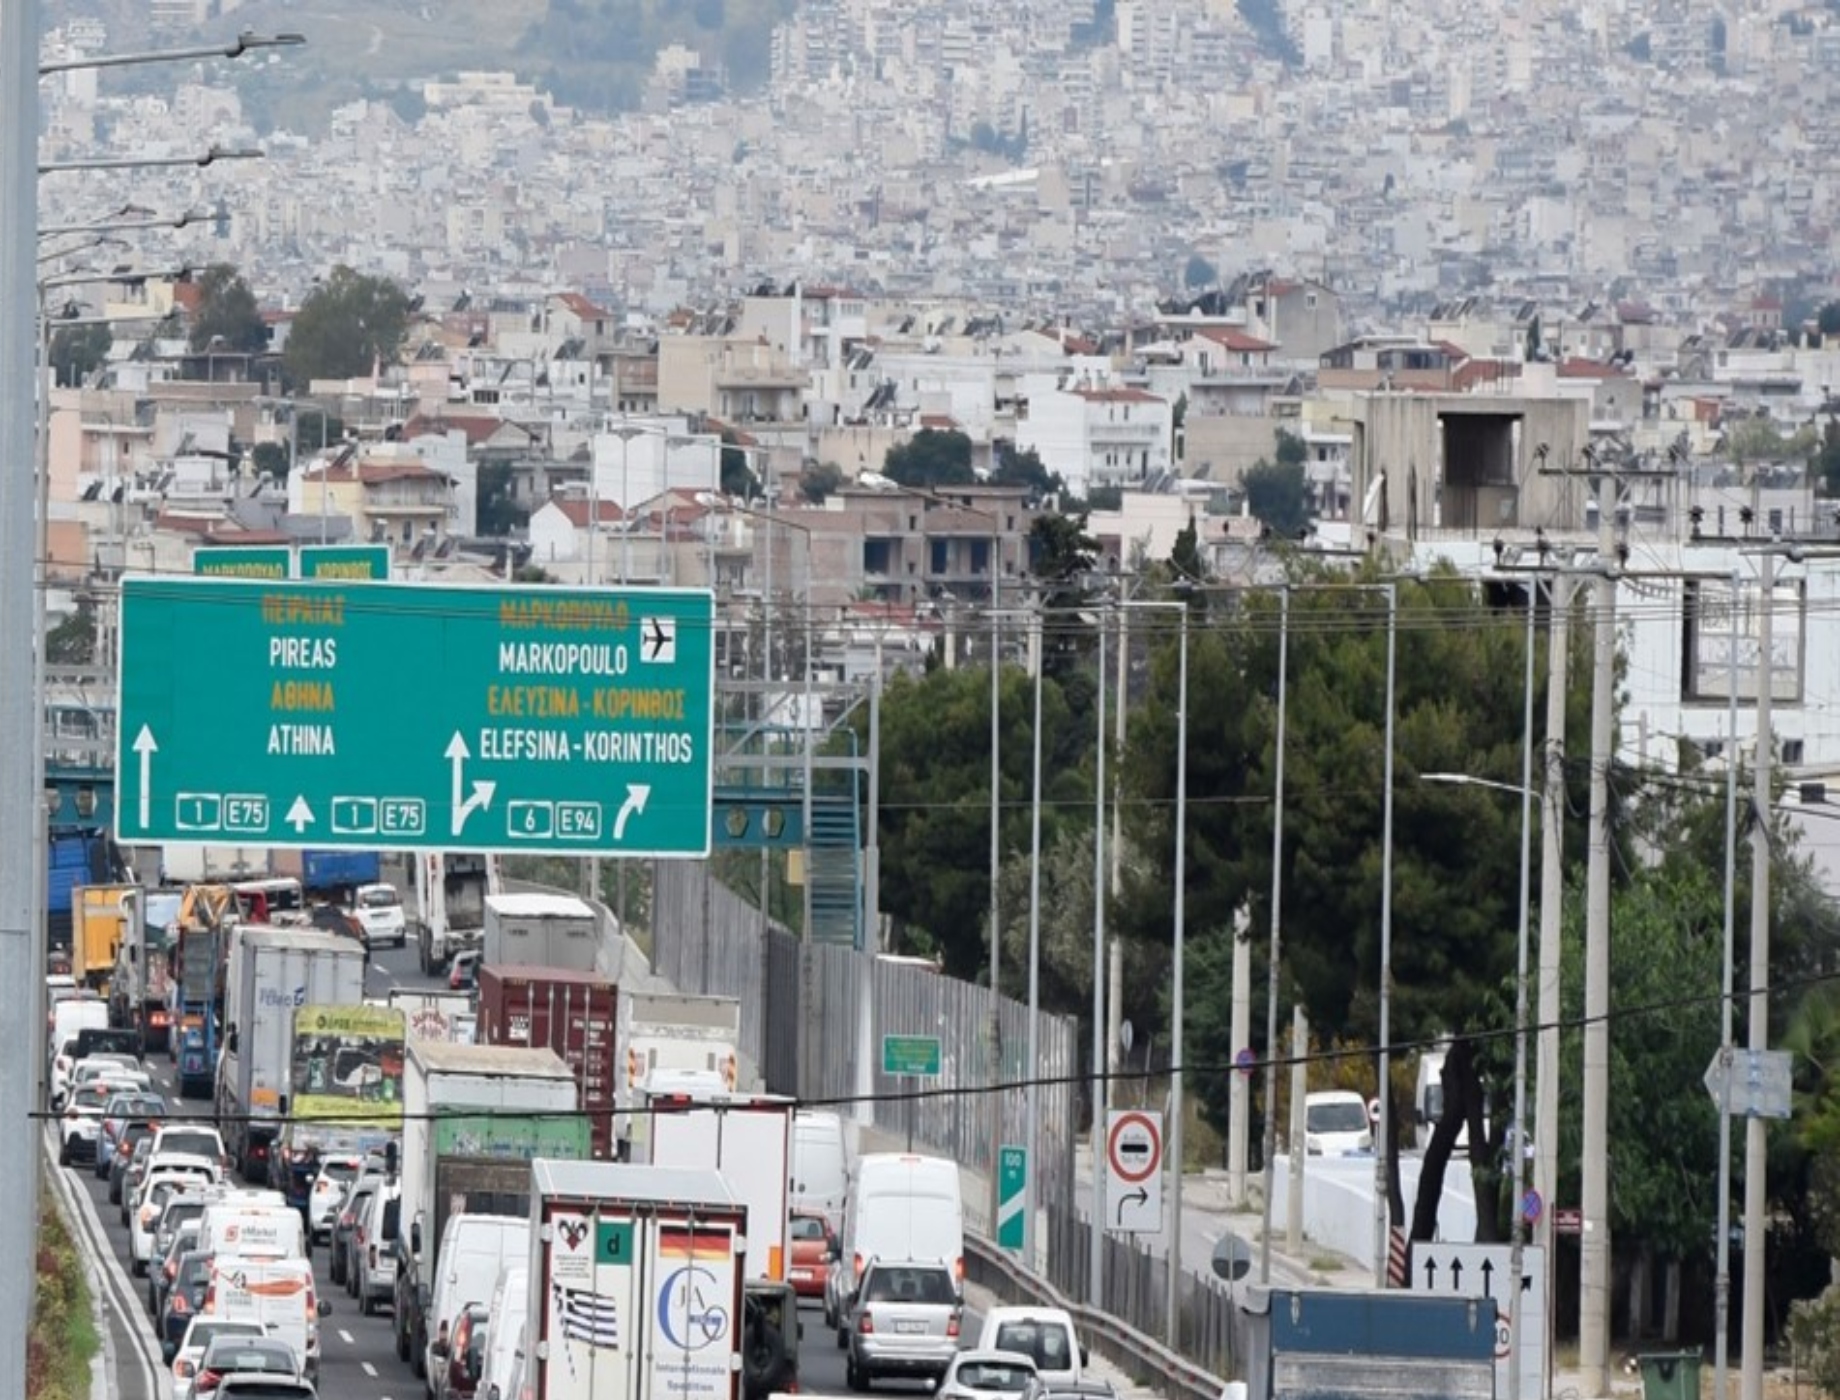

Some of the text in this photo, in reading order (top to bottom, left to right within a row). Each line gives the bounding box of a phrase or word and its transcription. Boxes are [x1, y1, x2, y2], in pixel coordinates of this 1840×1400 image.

[270, 637, 336, 668] PIREAS
[499, 642, 627, 675] MARKOPOULO
[271, 682, 334, 711] ΑΘΗΝΑ
[267, 724, 335, 755] ATHINA
[195, 801, 202, 822] 1
[351, 805, 358, 826] 1
[525, 808, 535, 832] 6
